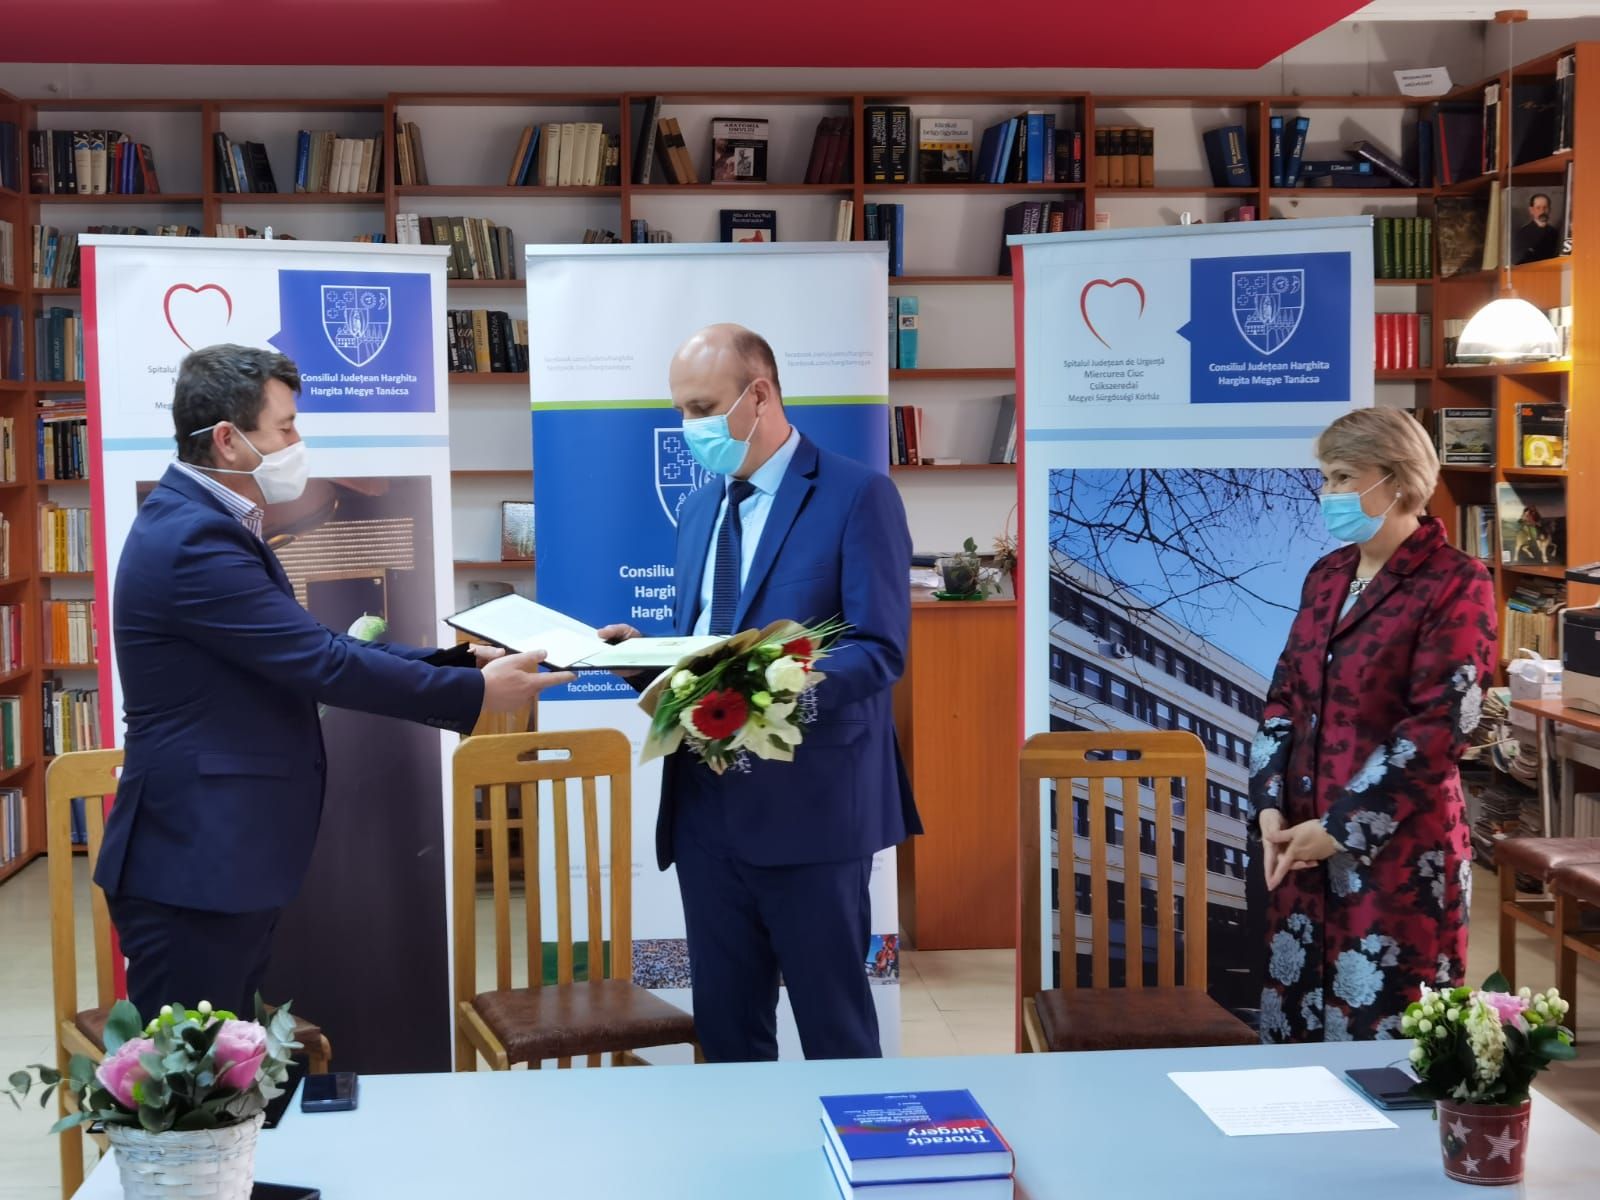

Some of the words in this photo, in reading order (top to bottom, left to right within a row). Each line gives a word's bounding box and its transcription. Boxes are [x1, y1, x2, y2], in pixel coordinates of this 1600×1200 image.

[1063, 359, 1089, 369] Spitalul
[1125, 358, 1135, 366] de
[1209, 362, 1246, 372] Consiliul
[1290, 360, 1330, 371] Harghita
[147, 365, 177, 374] Spitalul
[1084, 369, 1125, 378] Miercurea
[1127, 369, 1144, 378] Ciuc
[301, 373, 339, 383] Consiliul
[381, 374, 417, 385] Harghita
[1218, 376, 1250, 386] Hargita
[1252, 375, 1282, 386] Megye
[1284, 374, 1320, 384] Tanácsa
[310, 386, 342, 397] Hargita
[344, 386, 375, 397] Megye
[376, 386, 409, 396] Tanácsa
[1068, 394, 1094, 403] Megyei
[619, 565, 675, 578] Consiliu
[631, 605, 673, 620] Hargh
[907, 1126, 984, 1137] Surgery
[906, 1135, 990, 1146] Thoracic
